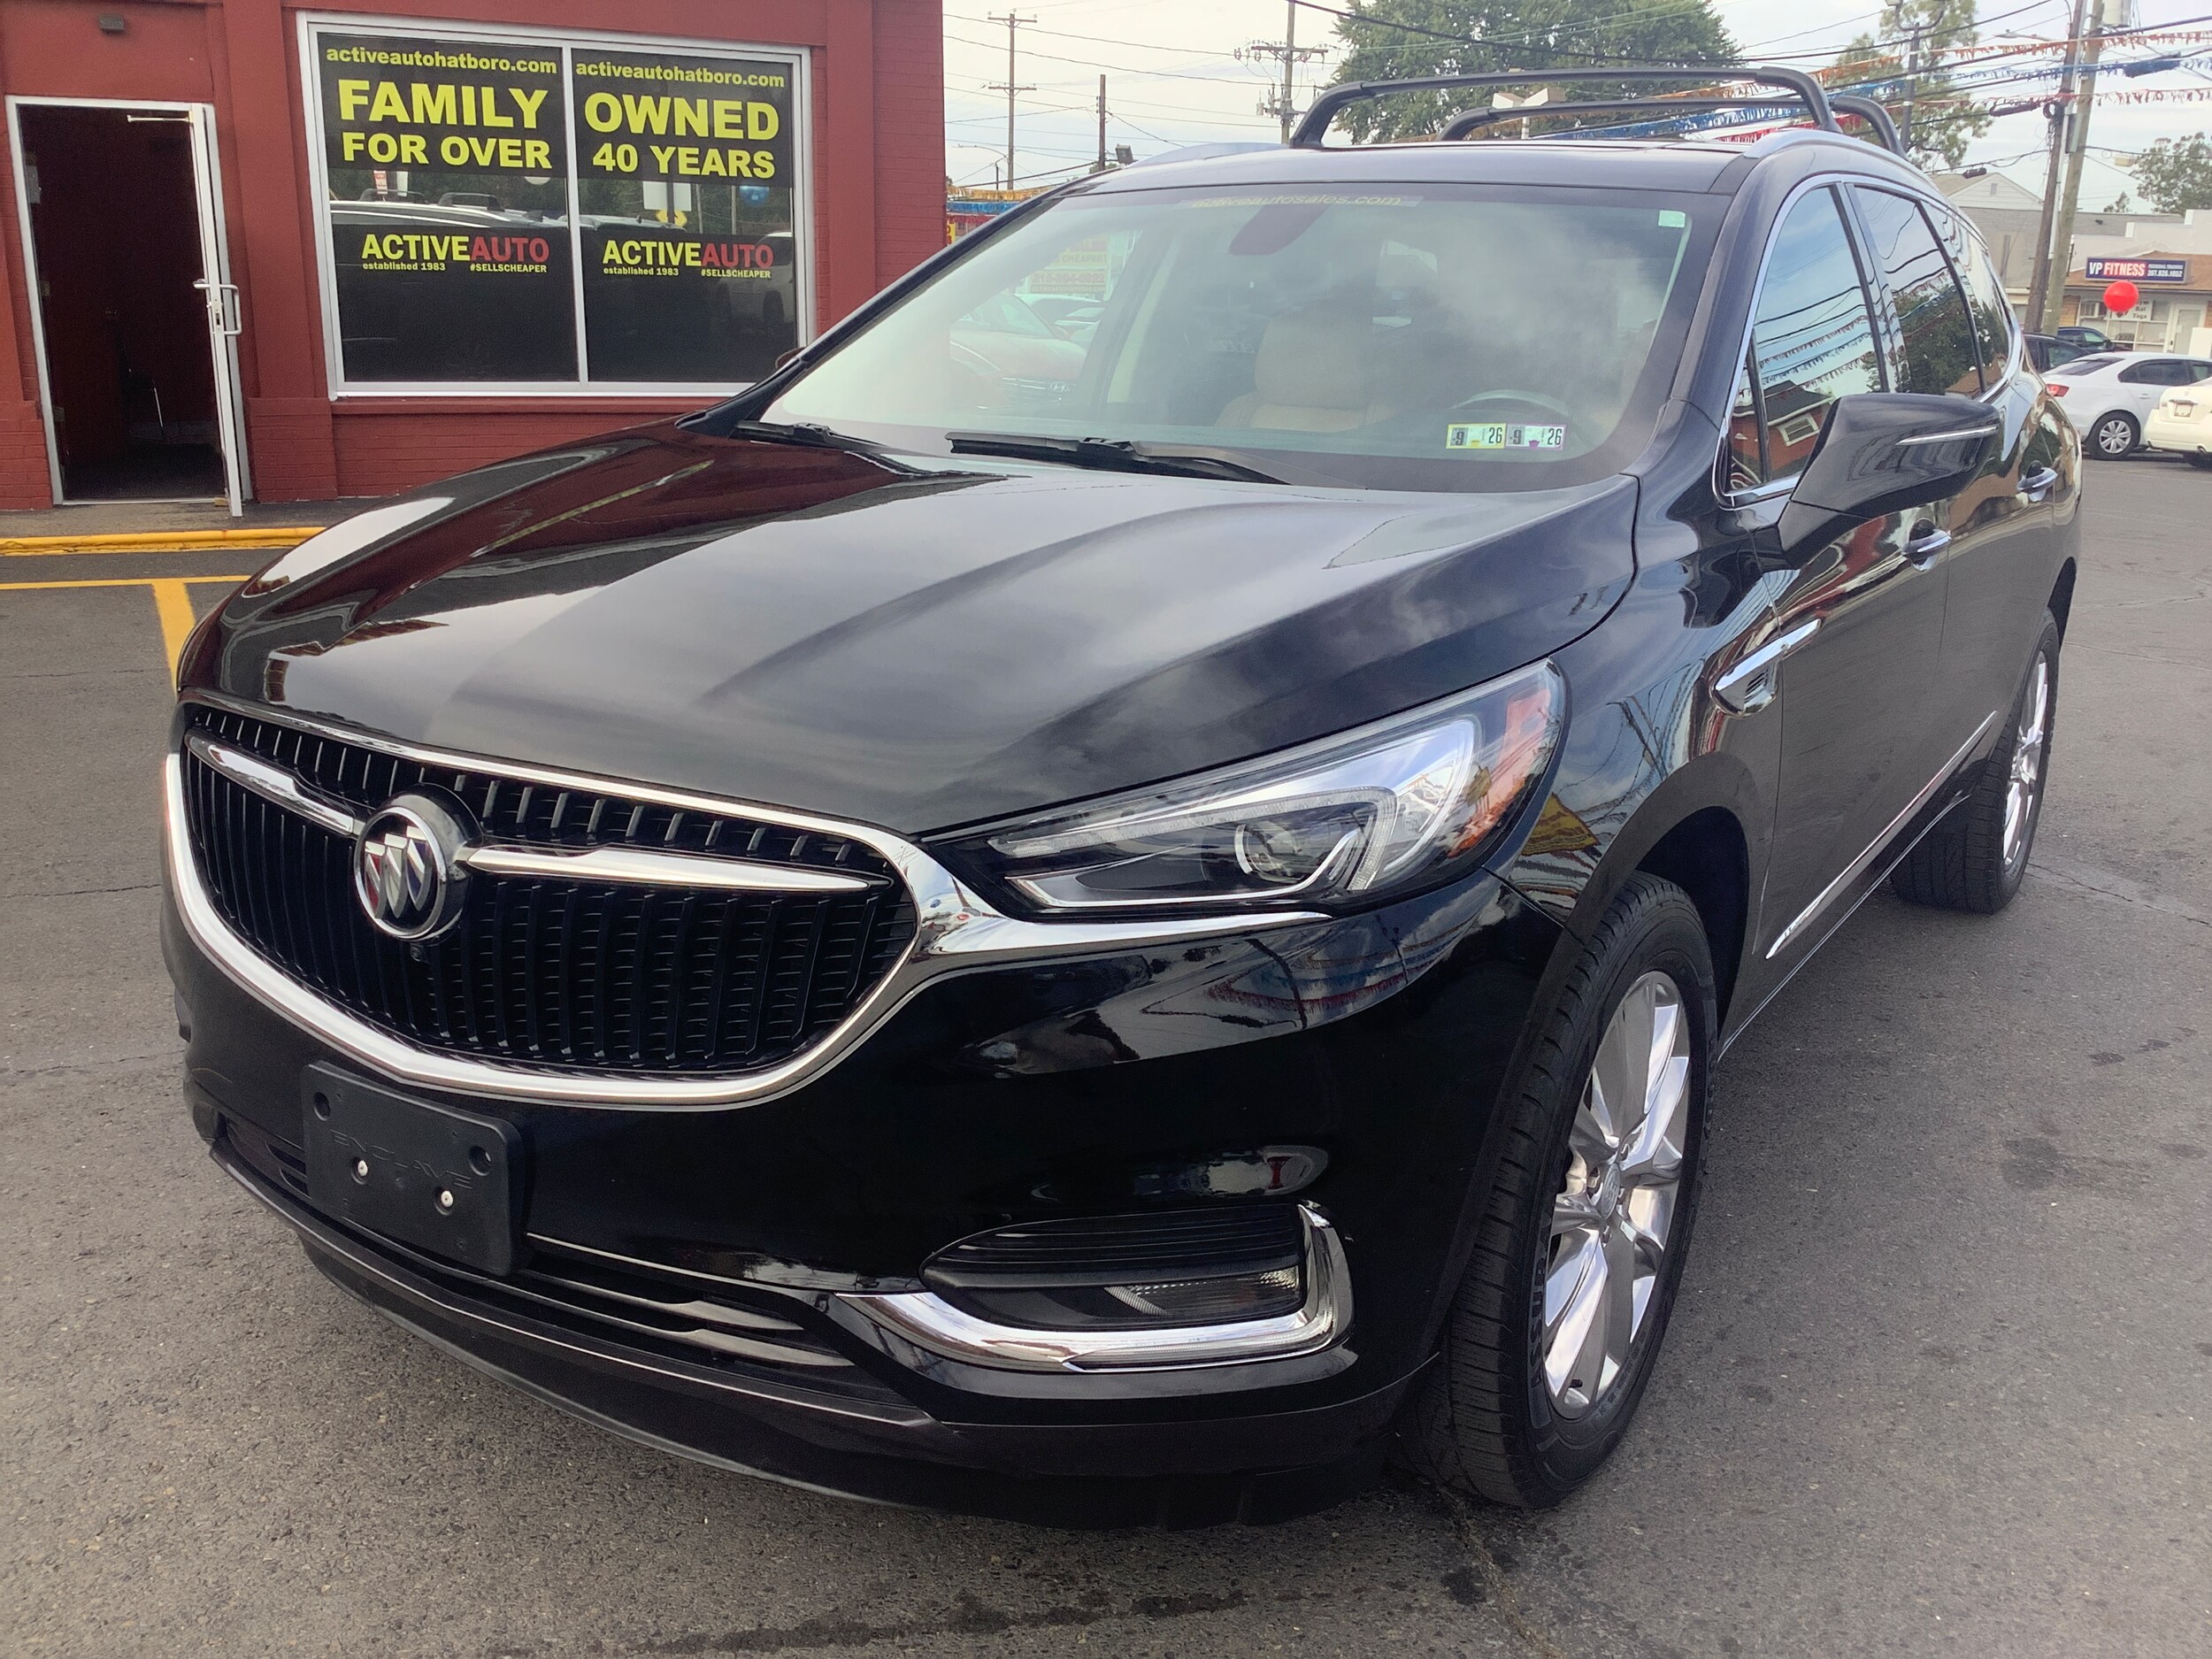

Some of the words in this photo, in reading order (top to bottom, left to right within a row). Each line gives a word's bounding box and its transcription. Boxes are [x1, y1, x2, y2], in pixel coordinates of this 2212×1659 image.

[326, 47, 557, 73] activeautohatboro.com
[576, 62, 785, 88] activeautohatboro.com
[338, 79, 549, 128] FAMILY
[584, 92, 780, 141] OWNED
[342, 132, 429, 165] FOR
[441, 136, 552, 169] OVER
[593, 142, 638, 173] 40
[649, 145, 776, 179] YEARS
[361, 234, 550, 263] ACTIVEAUTO
[603, 240, 774, 269] ACTIVEAUTO
[363, 262, 419, 271] established
[470, 263, 547, 273] #SELLSCHEAPER
[603, 266, 655, 275] established
[701, 268, 771, 279] #SELLSCHEAPER
[2089, 262, 2103, 275] VP
[2103, 262, 2146, 277] FITNESS
[1488, 426, 1502, 444] 26
[1548, 427, 1563, 445] 26
